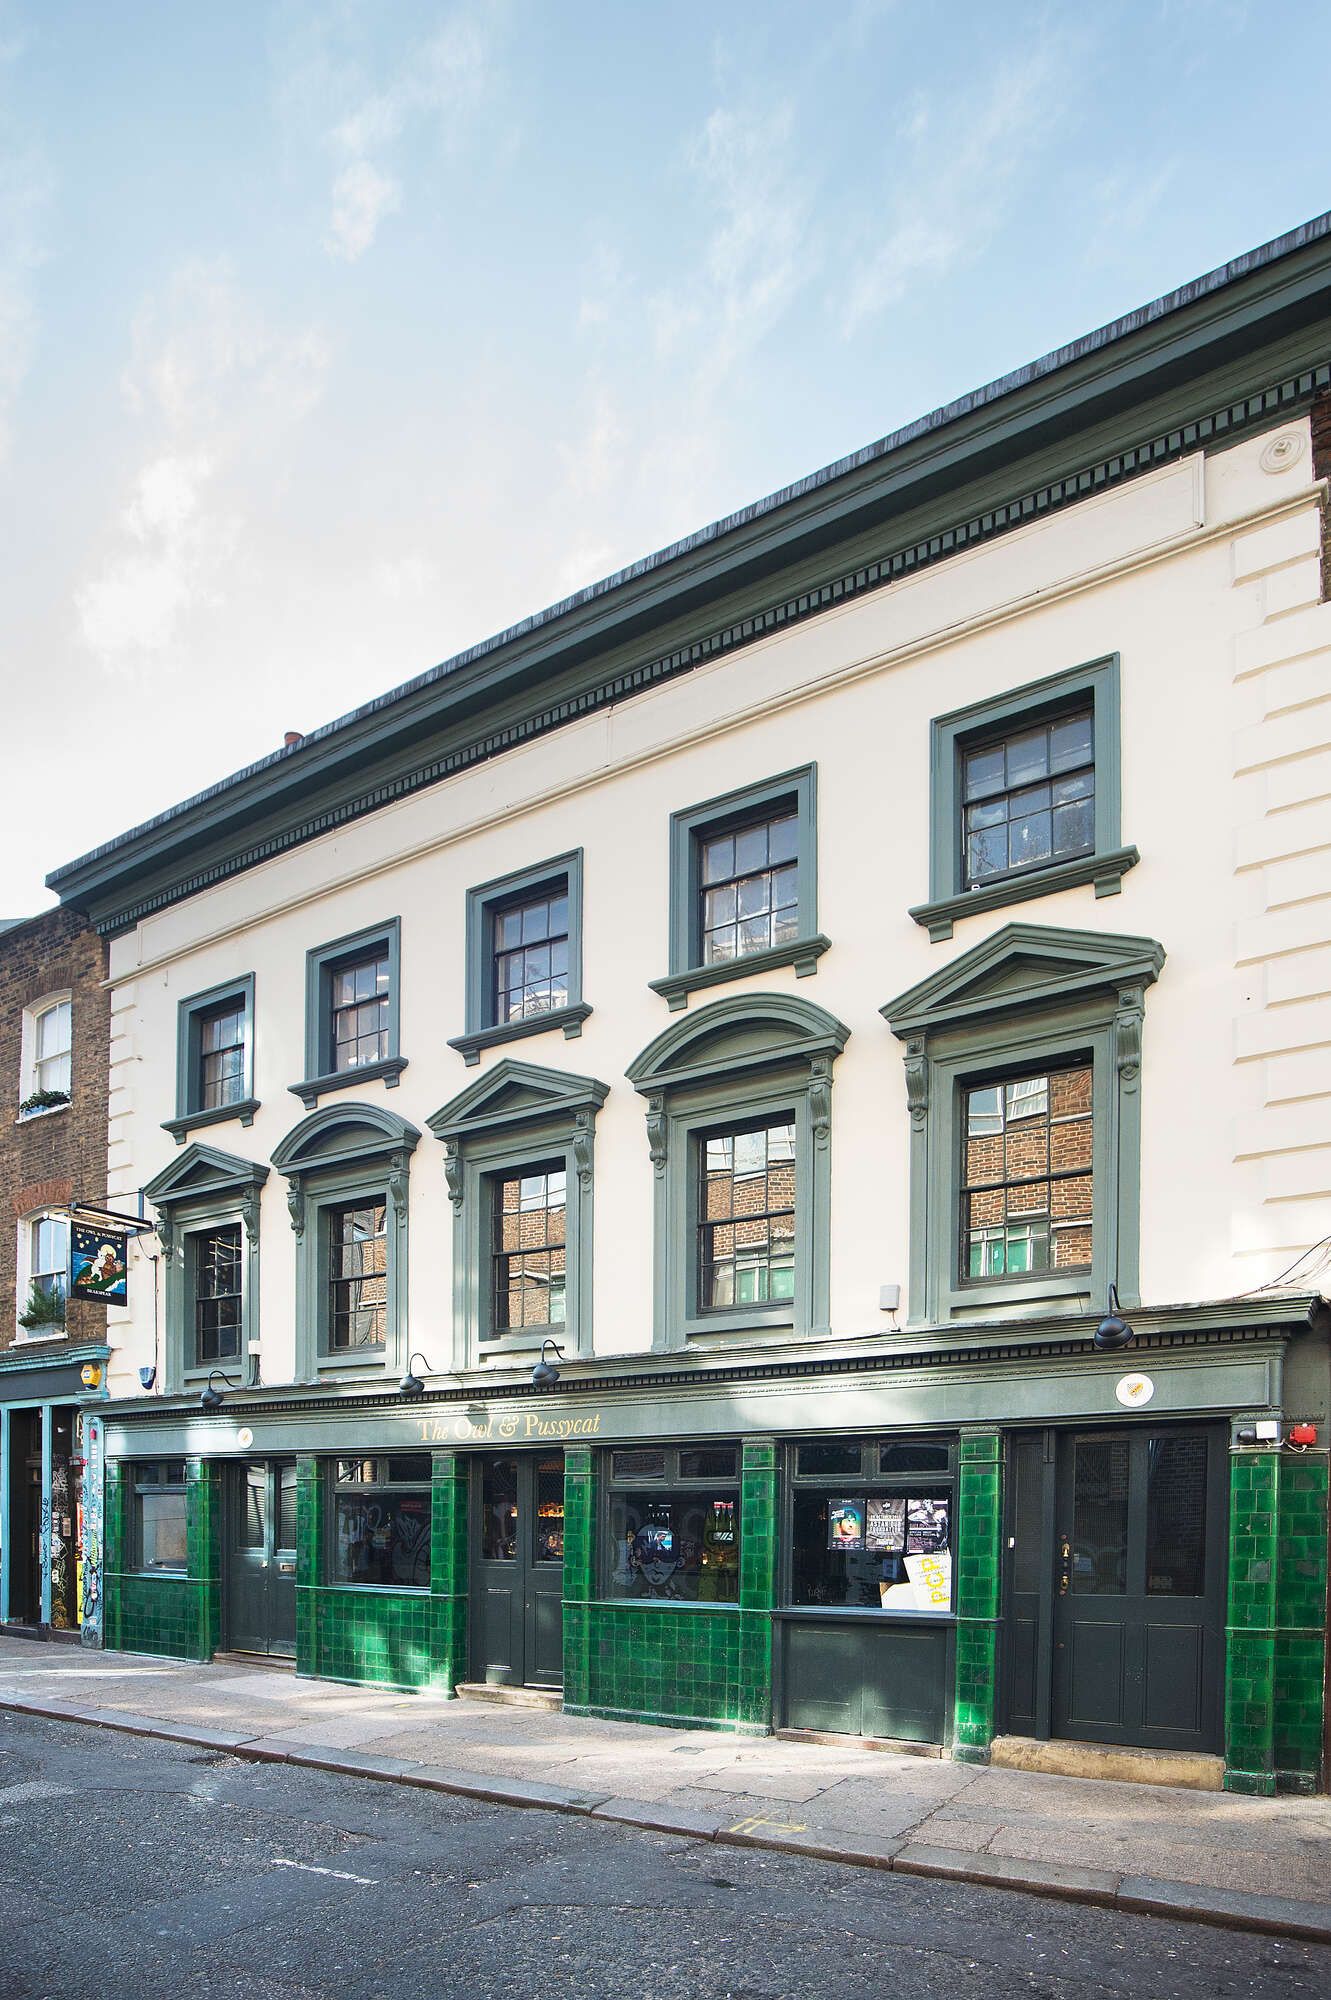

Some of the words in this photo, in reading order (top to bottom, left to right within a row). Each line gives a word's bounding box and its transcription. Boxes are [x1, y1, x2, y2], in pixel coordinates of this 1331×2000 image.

[417, 1418, 448, 1441] The
[454, 1414, 494, 1440] Owl
[498, 1415, 520, 1438] &
[524, 1413, 601, 1440] Pussycat
